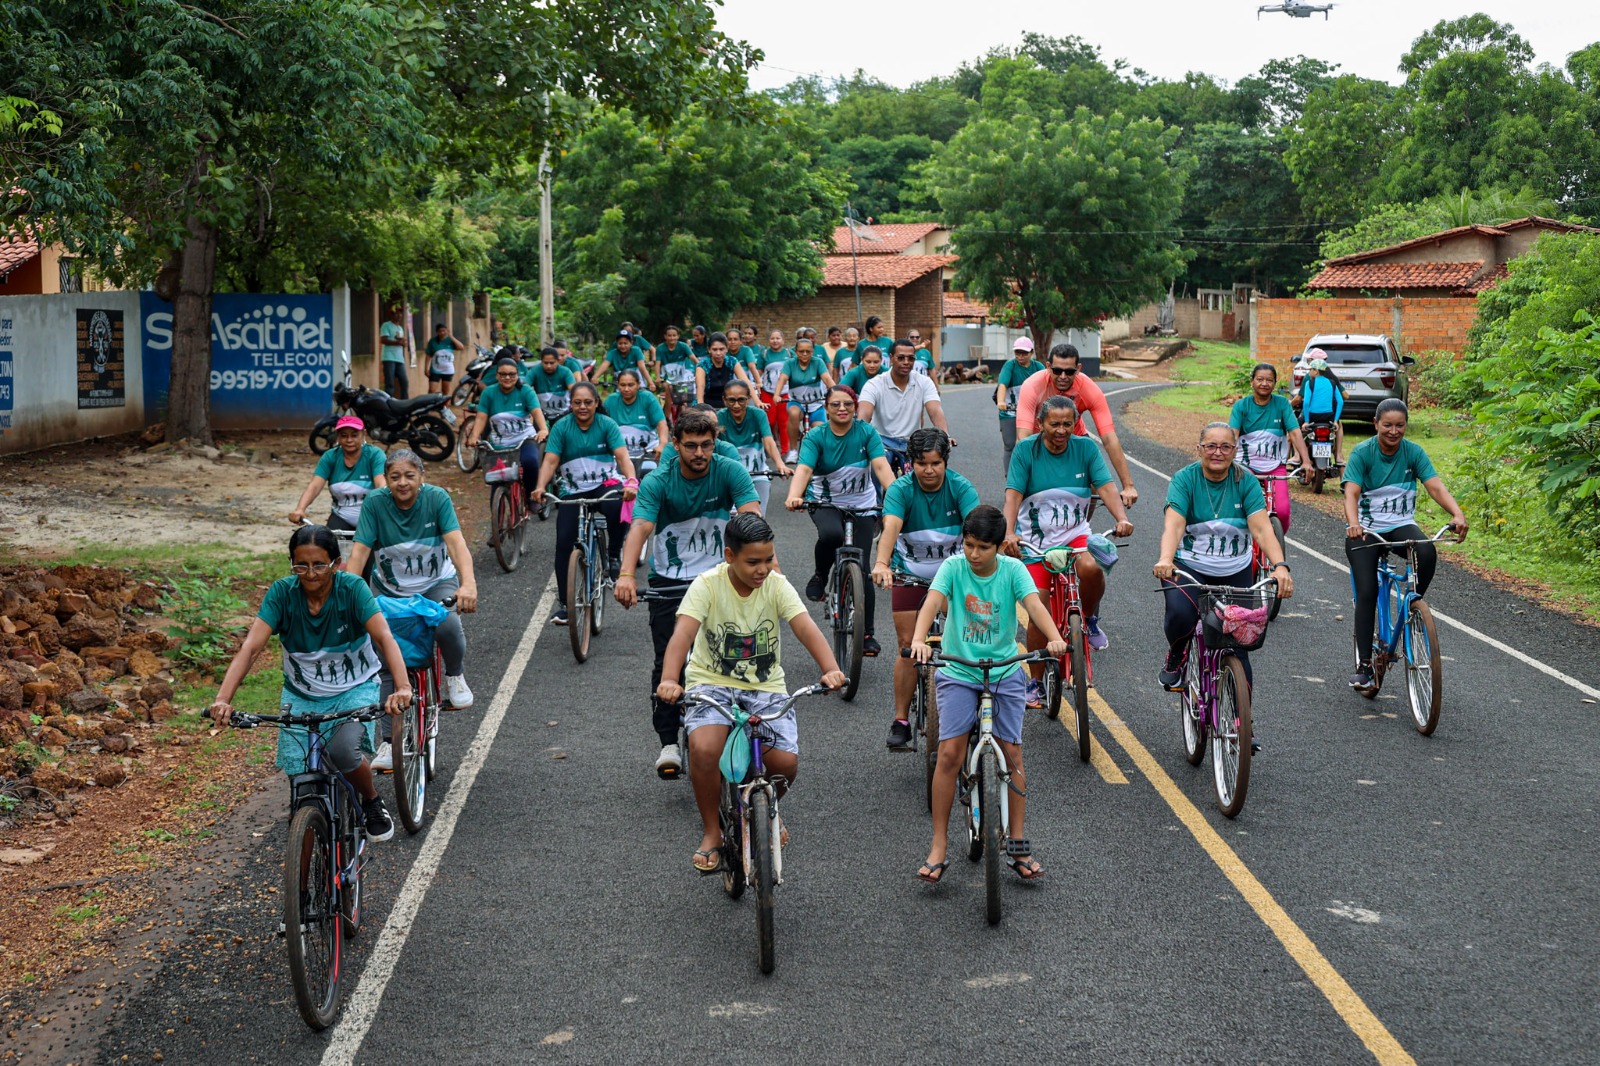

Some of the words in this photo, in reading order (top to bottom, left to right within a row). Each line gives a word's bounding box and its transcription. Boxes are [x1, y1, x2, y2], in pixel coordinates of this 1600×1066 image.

[211, 312, 332, 350] Asatnet
[251, 353, 332, 367] TELECOM
[210, 369, 332, 390] 99519-7000
